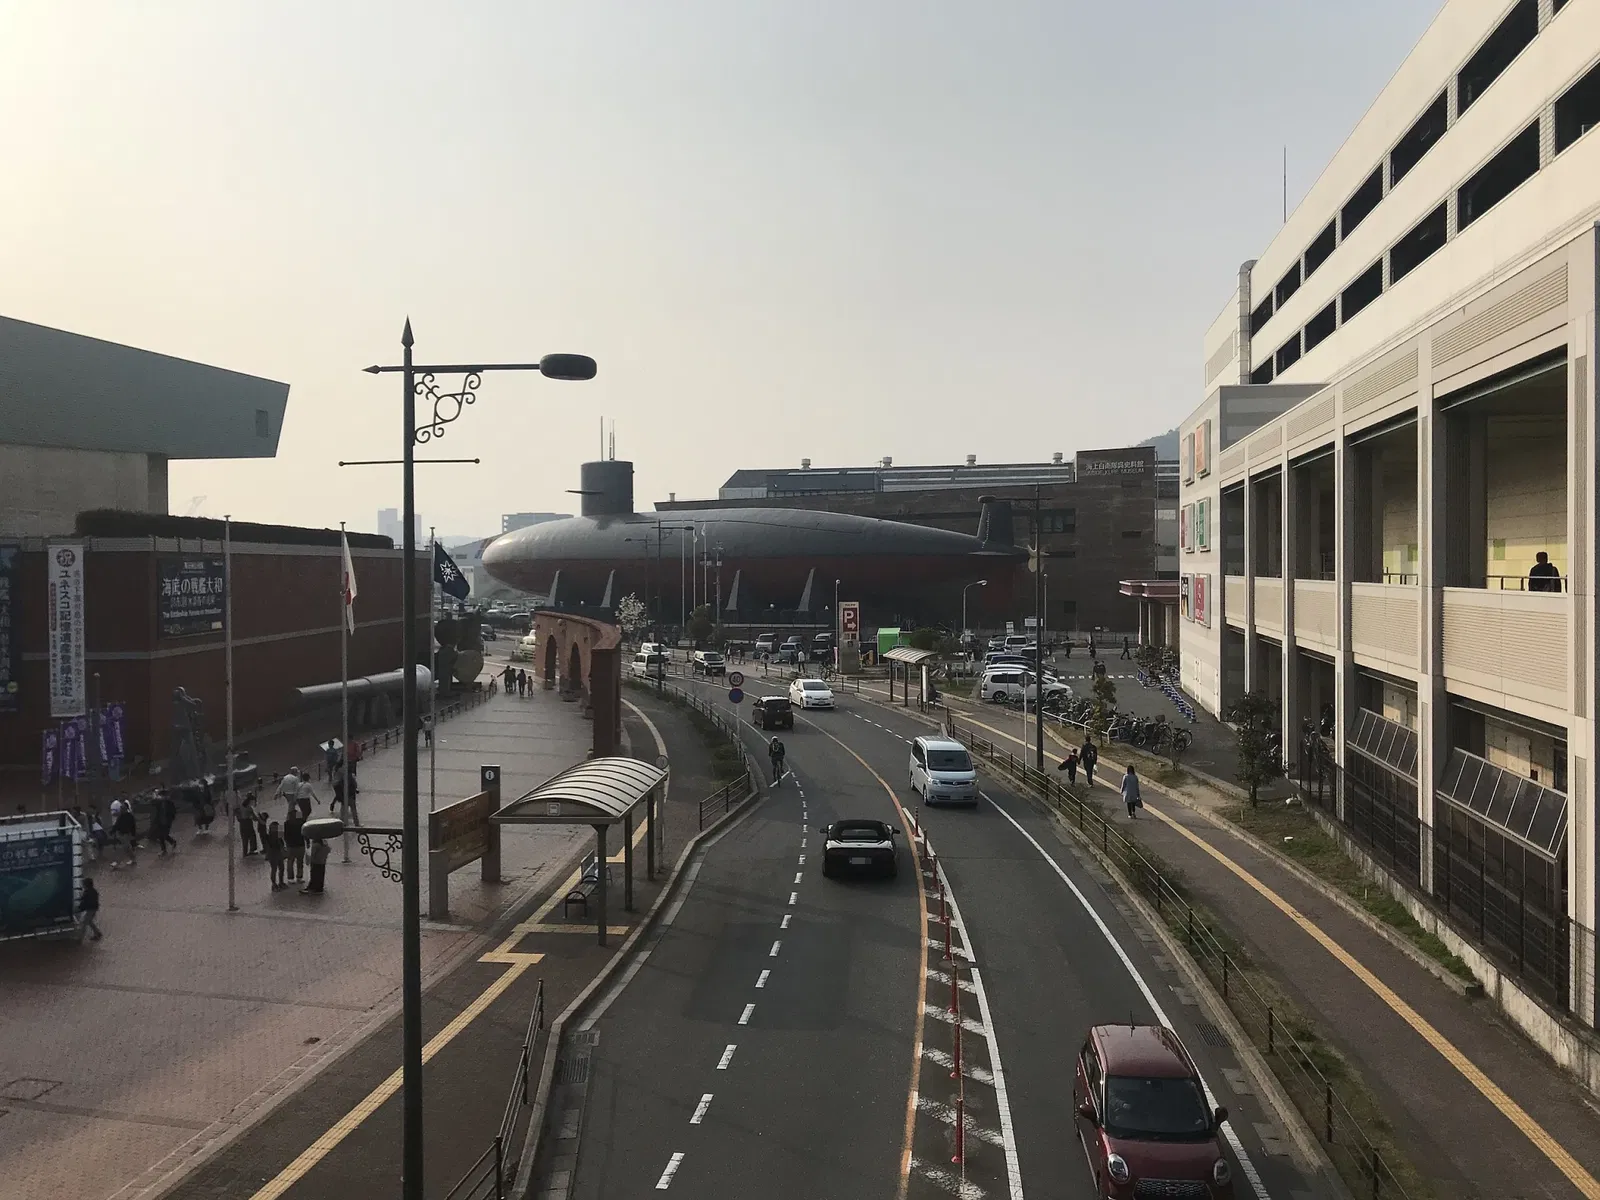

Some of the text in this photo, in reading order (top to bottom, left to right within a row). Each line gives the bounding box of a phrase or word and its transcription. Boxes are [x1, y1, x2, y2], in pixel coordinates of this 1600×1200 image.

[1085, 460, 1144, 470] 海上自衛隊呉史料館
[57, 549, 75, 567] 祝
[162, 577, 222, 596] 海底の戦艦大和
[844, 610, 855, 623] P
